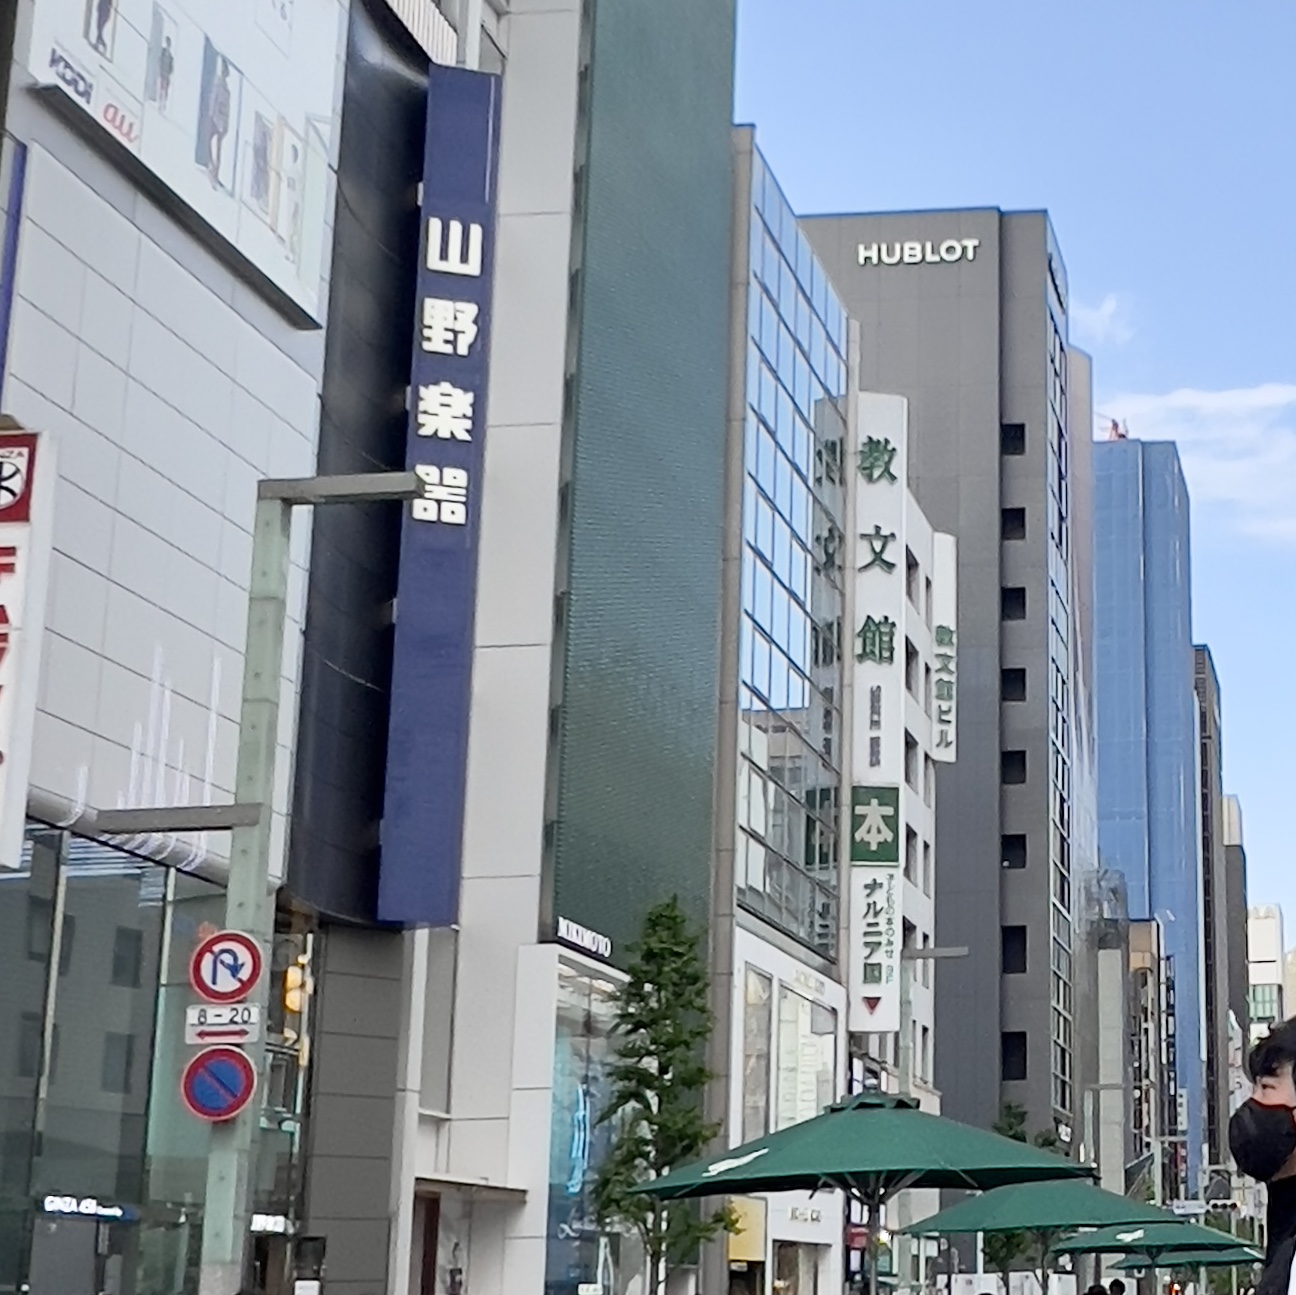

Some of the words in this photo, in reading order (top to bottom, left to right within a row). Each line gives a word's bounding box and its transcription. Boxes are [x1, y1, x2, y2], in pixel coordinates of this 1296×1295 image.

[103, 102, 140, 144] au
[857, 238, 980, 266] HUBLOT
[412, 217, 483, 525] 山野楽器
[856, 434, 899, 667] 教文館
[853, 798, 895, 851] 本
[862, 877, 884, 985] ナルニア国
